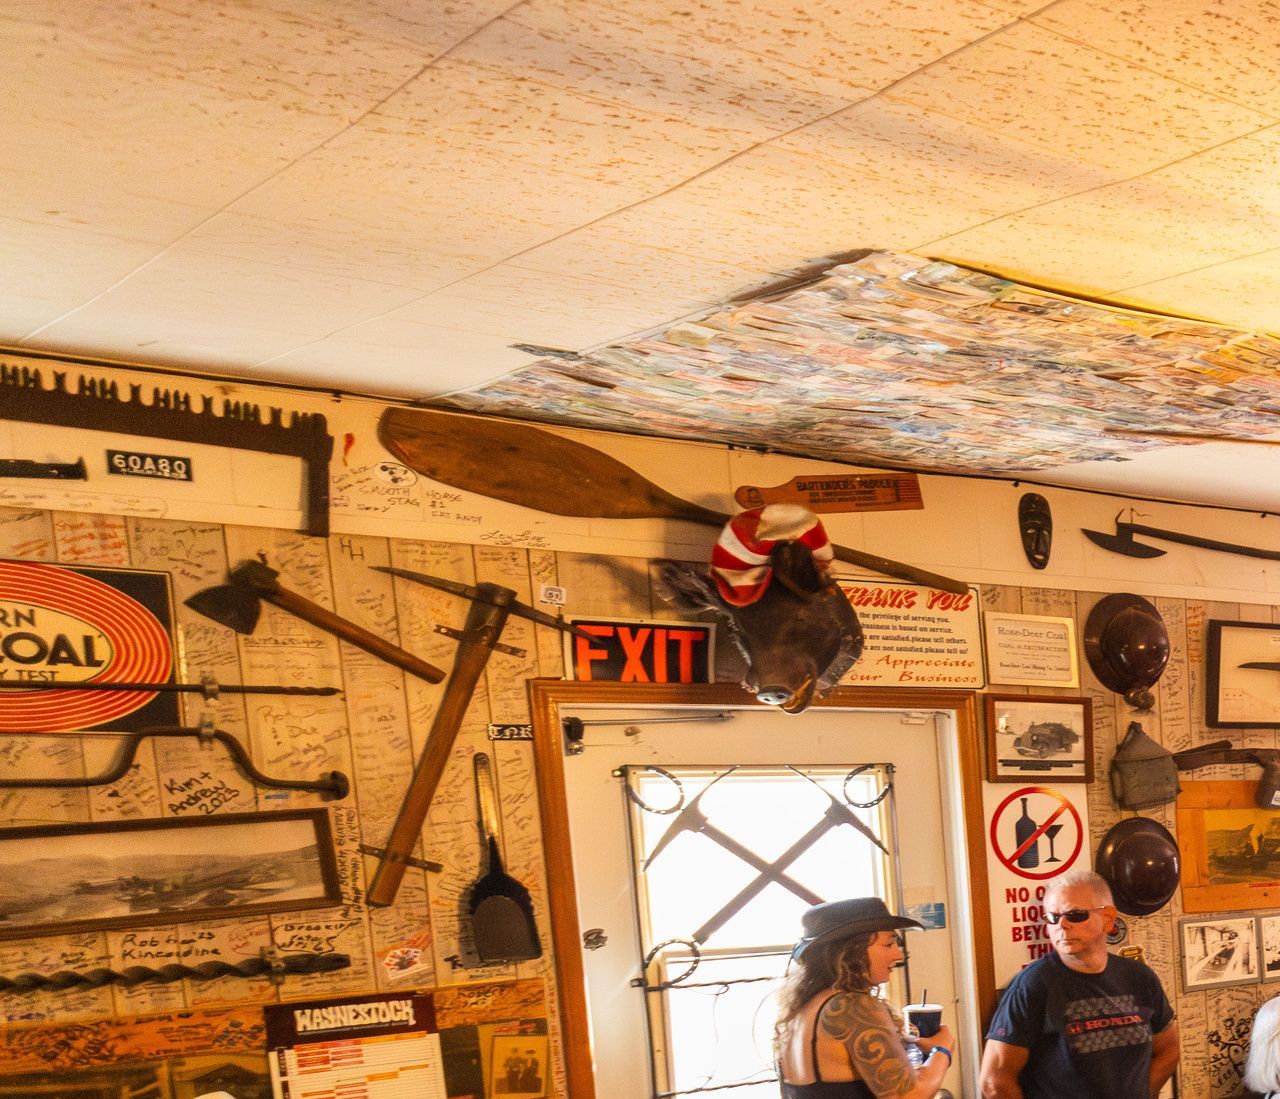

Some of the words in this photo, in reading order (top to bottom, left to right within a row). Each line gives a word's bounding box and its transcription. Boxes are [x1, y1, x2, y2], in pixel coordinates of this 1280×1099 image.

[927, 589, 973, 612] YOU
[872, 613, 901, 622] privilege
[911, 615, 935, 623] serving
[899, 624, 917, 632] based
[0, 632, 104, 668] OAL
[577, 624, 706, 684] EXIT
[875, 655, 976, 669] Appreciate
[897, 671, 977, 683] Business
[168, 780, 228, 815] Andrew
[199, 786, 240, 815] 2023
[1005, 887, 1030, 904] NO
[294, 999, 416, 1032] WAYNESTOCK
[1086, 1015, 1143, 1031] HONDA
